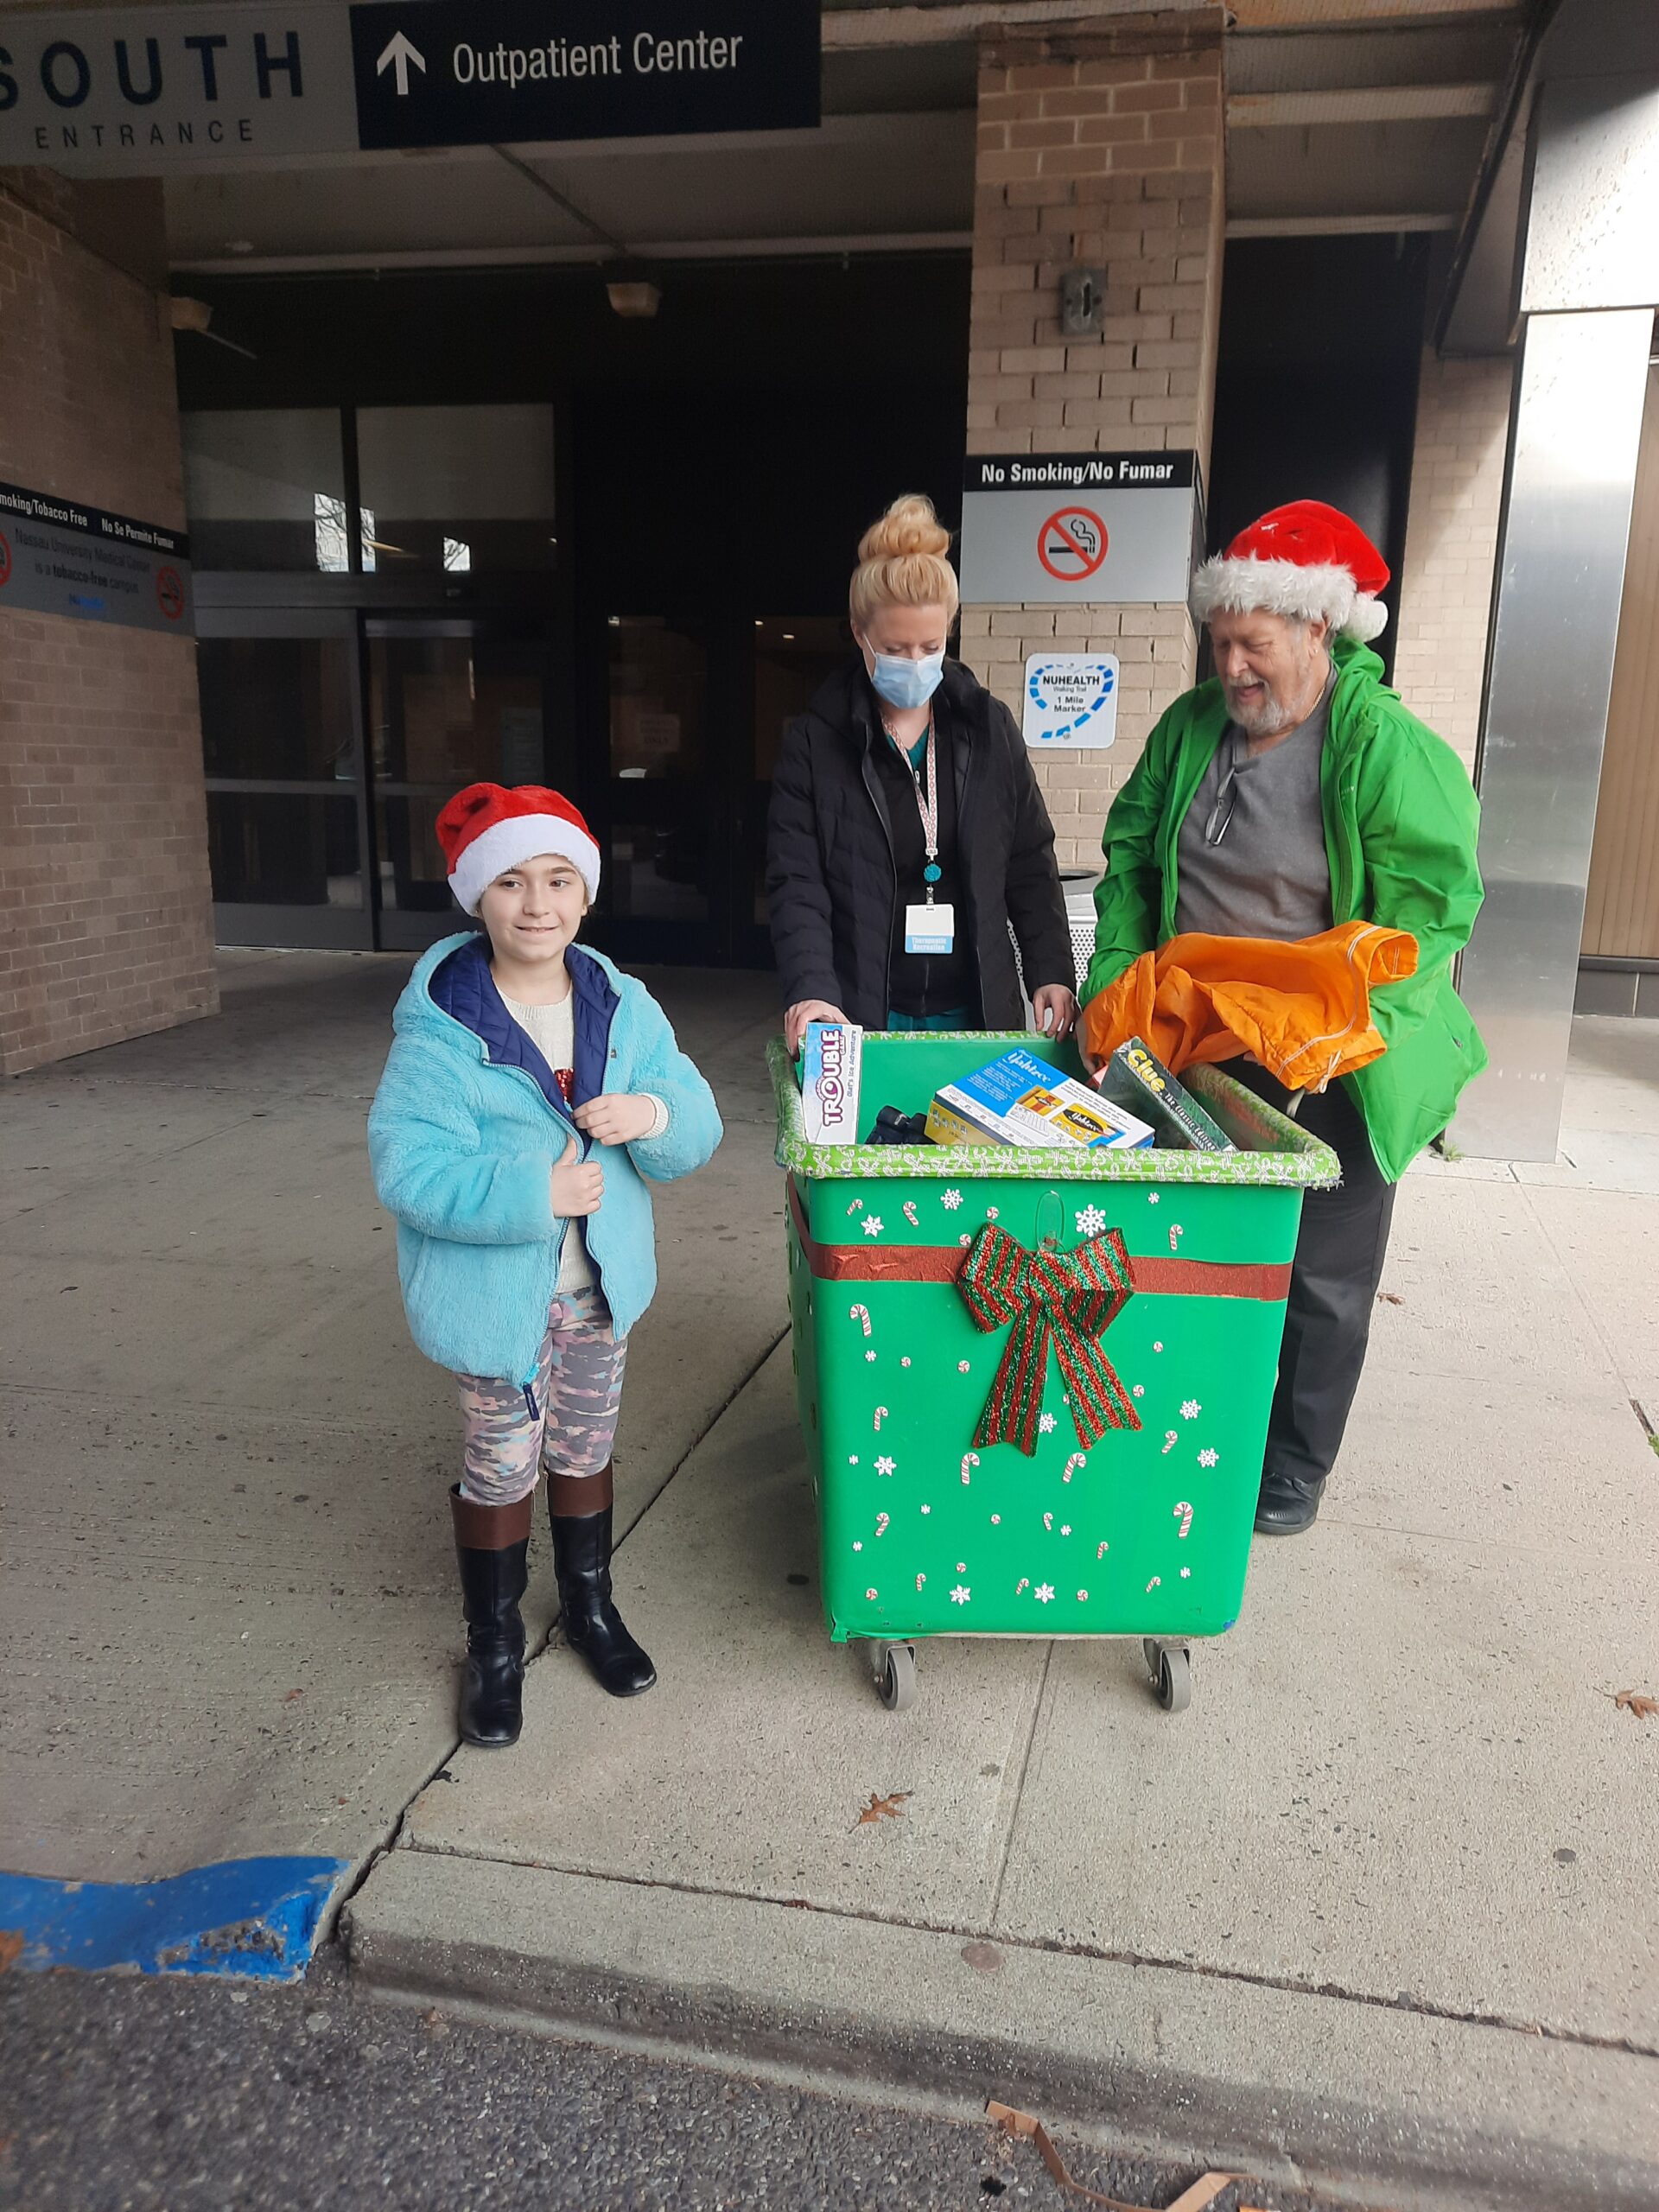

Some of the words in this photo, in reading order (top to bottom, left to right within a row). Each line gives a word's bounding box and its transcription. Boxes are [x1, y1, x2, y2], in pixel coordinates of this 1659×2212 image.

[453, 36, 622, 89] Outpatient
[633, 29, 743, 74] Center
[35, 118, 253, 150] ENTRANCE
[982, 463, 1005, 483] No
[1010, 461, 1114, 485] Smoking/No
[1119, 460, 1174, 480] Fumar
[15, 528, 49, 550] Nassau
[70, 508, 88, 527] Free
[101, 518, 113, 533] No
[114, 521, 124, 537] Se
[125, 524, 153, 544] Permite
[53, 563, 108, 588] tobacco-free
[1043, 676, 1100, 685] NUHEALTH
[821, 1029, 843, 1127] TROUBLE
[1003, 1052, 1051, 1083] Yahtzee
[1128, 1049, 1166, 1092] Clue
[1164, 1092, 1176, 1107] The
[1175, 1104, 1195, 1128] Classic
